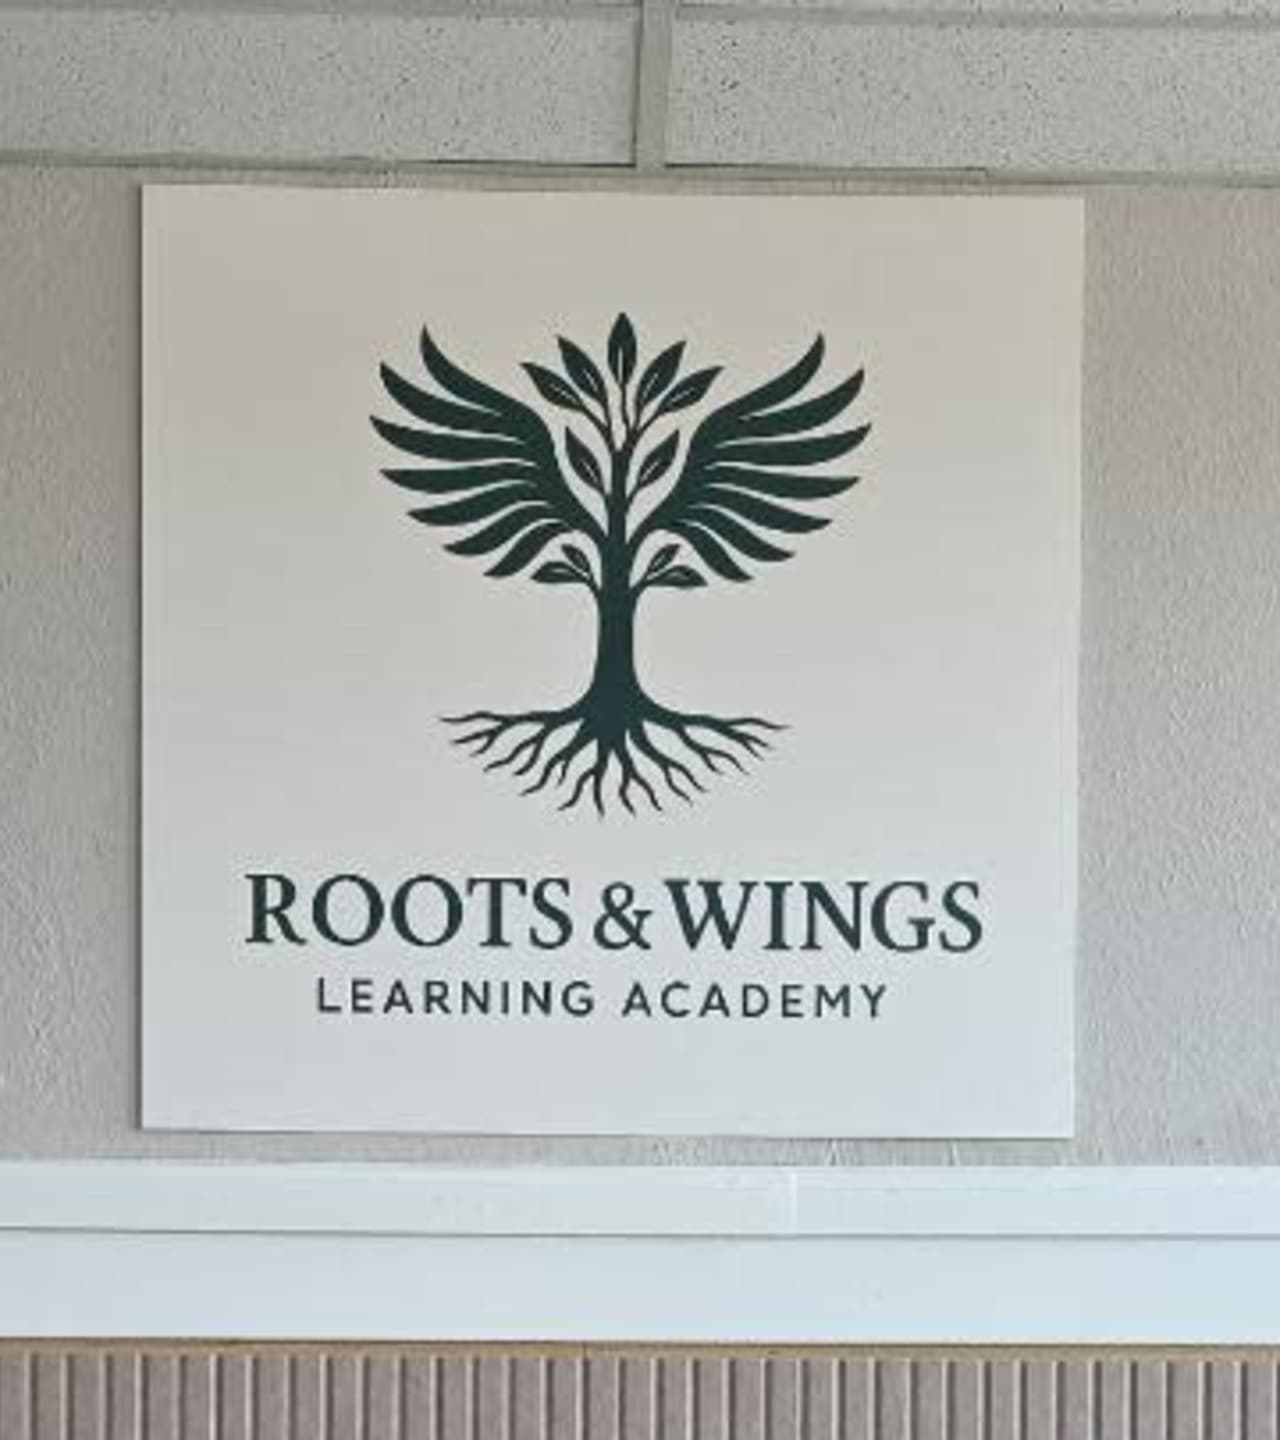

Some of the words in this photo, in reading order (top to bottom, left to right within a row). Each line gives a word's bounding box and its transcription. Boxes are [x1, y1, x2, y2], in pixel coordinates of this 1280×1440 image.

[244, 873, 574, 951] ROOTS
[592, 880, 654, 952] &
[663, 878, 984, 954] WINGS
[317, 976, 595, 1018] LEARNING
[620, 981, 888, 1019] ACADEMY
